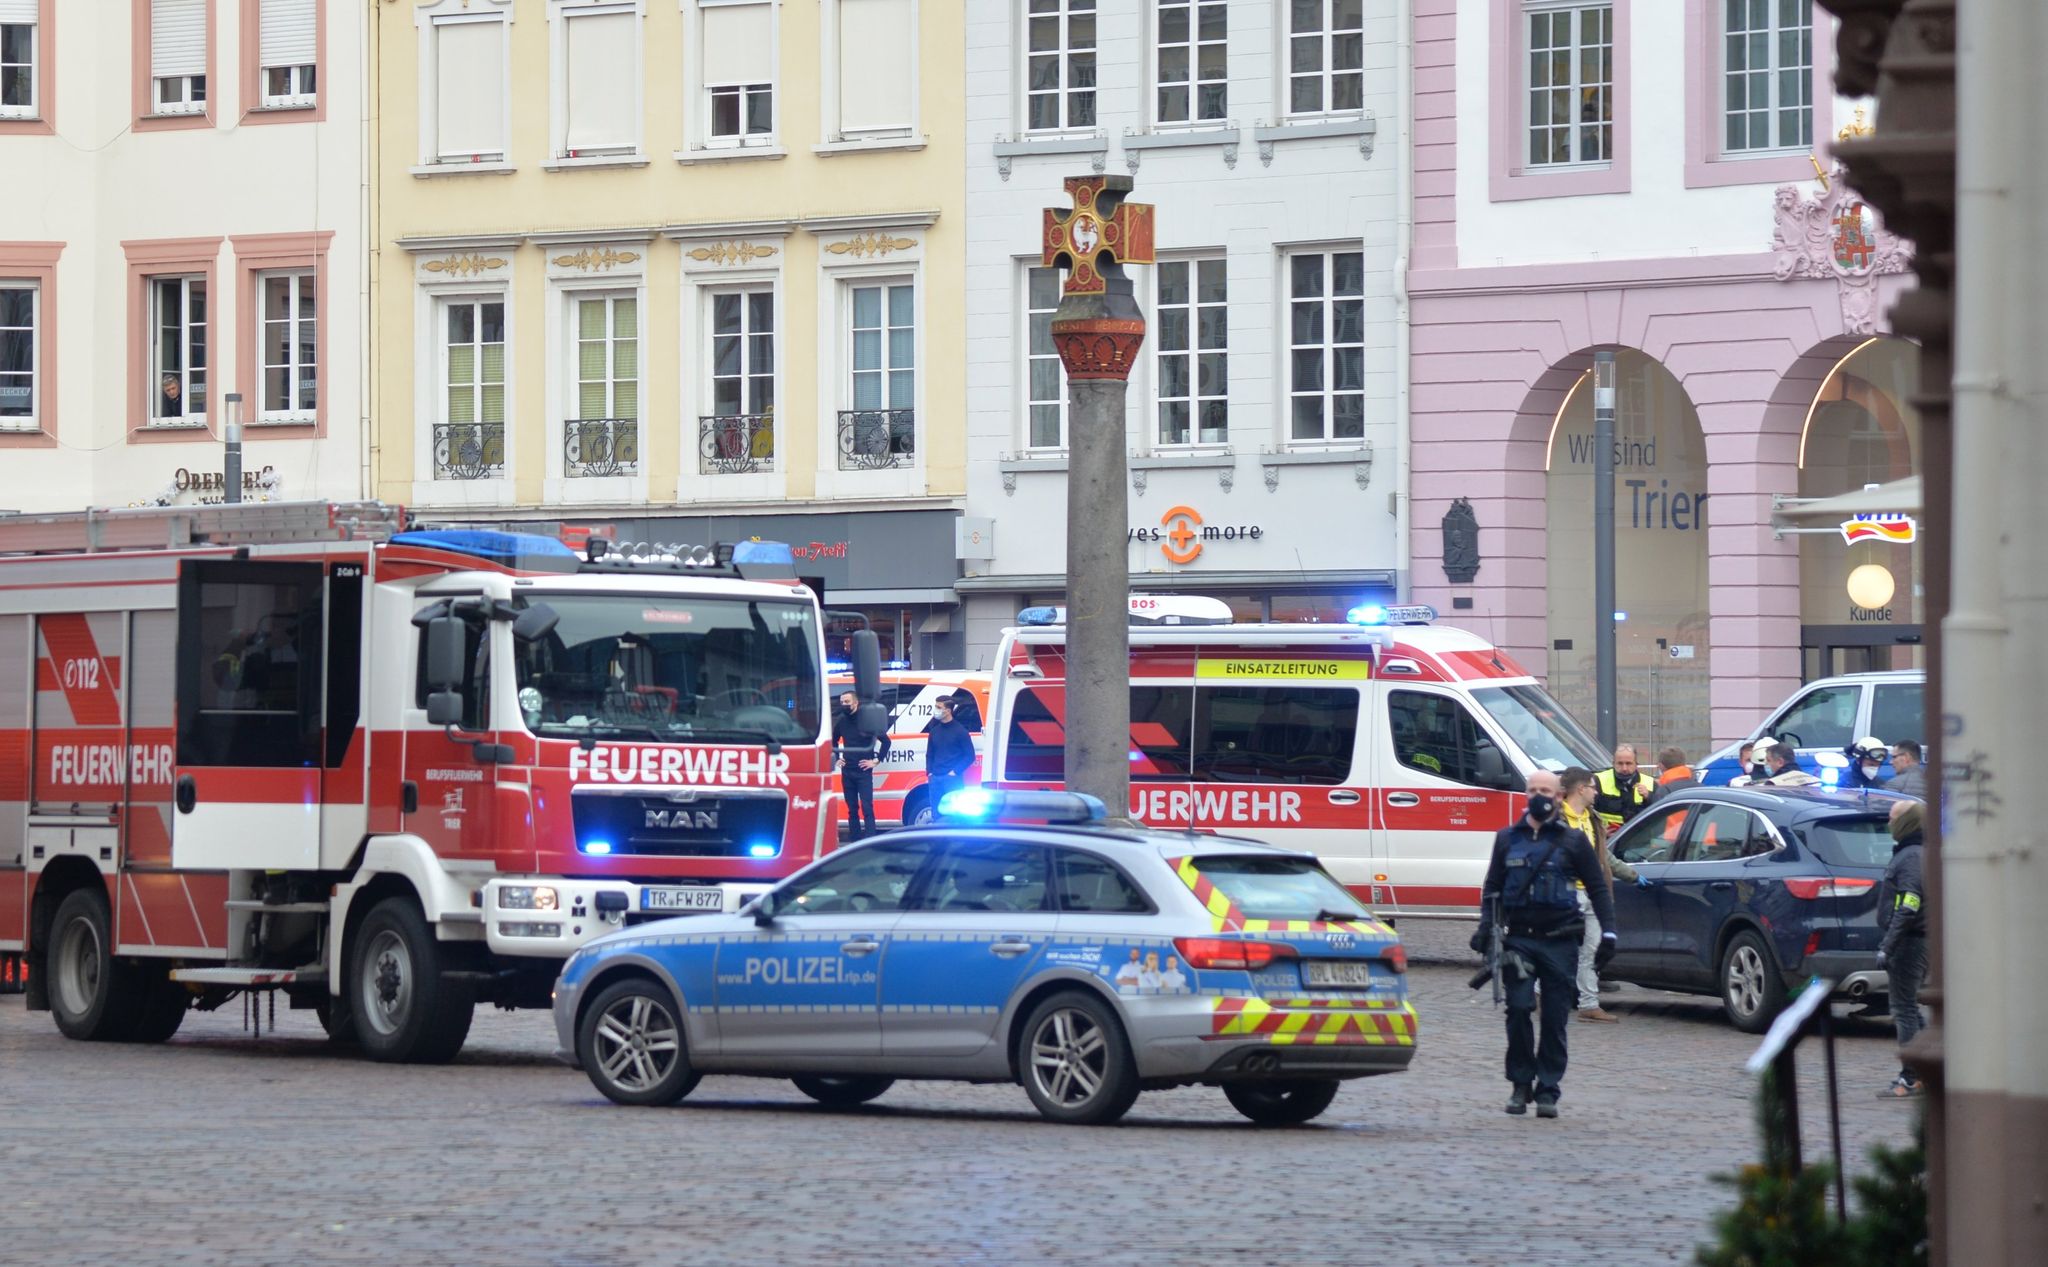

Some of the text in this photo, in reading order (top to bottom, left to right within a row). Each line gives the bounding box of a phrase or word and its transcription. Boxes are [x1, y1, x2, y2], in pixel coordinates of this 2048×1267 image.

[1568, 434, 1654, 466] Wi sind
[175, 465, 274, 491] OBEREIS
[1625, 479, 1710, 530] Trier
[1128, 525, 1260, 543] yes more
[793, 541, 847, 560] en-Treff
[1132, 600, 1155, 608] BOS
[1850, 606, 1892, 621] Kunde
[76, 658, 99, 689] 112
[1226, 663, 1338, 675] EINSATZLEITUNG
[918, 704, 932, 716] 112
[51, 744, 173, 785] FEUERWEHR
[569, 746, 790, 786] FEUERWEHR
[1127, 790, 1302, 822] UERWEHR
[645, 811, 719, 829] MAN
[650, 891, 667, 906] TR
[696, 892, 720, 907] 877
